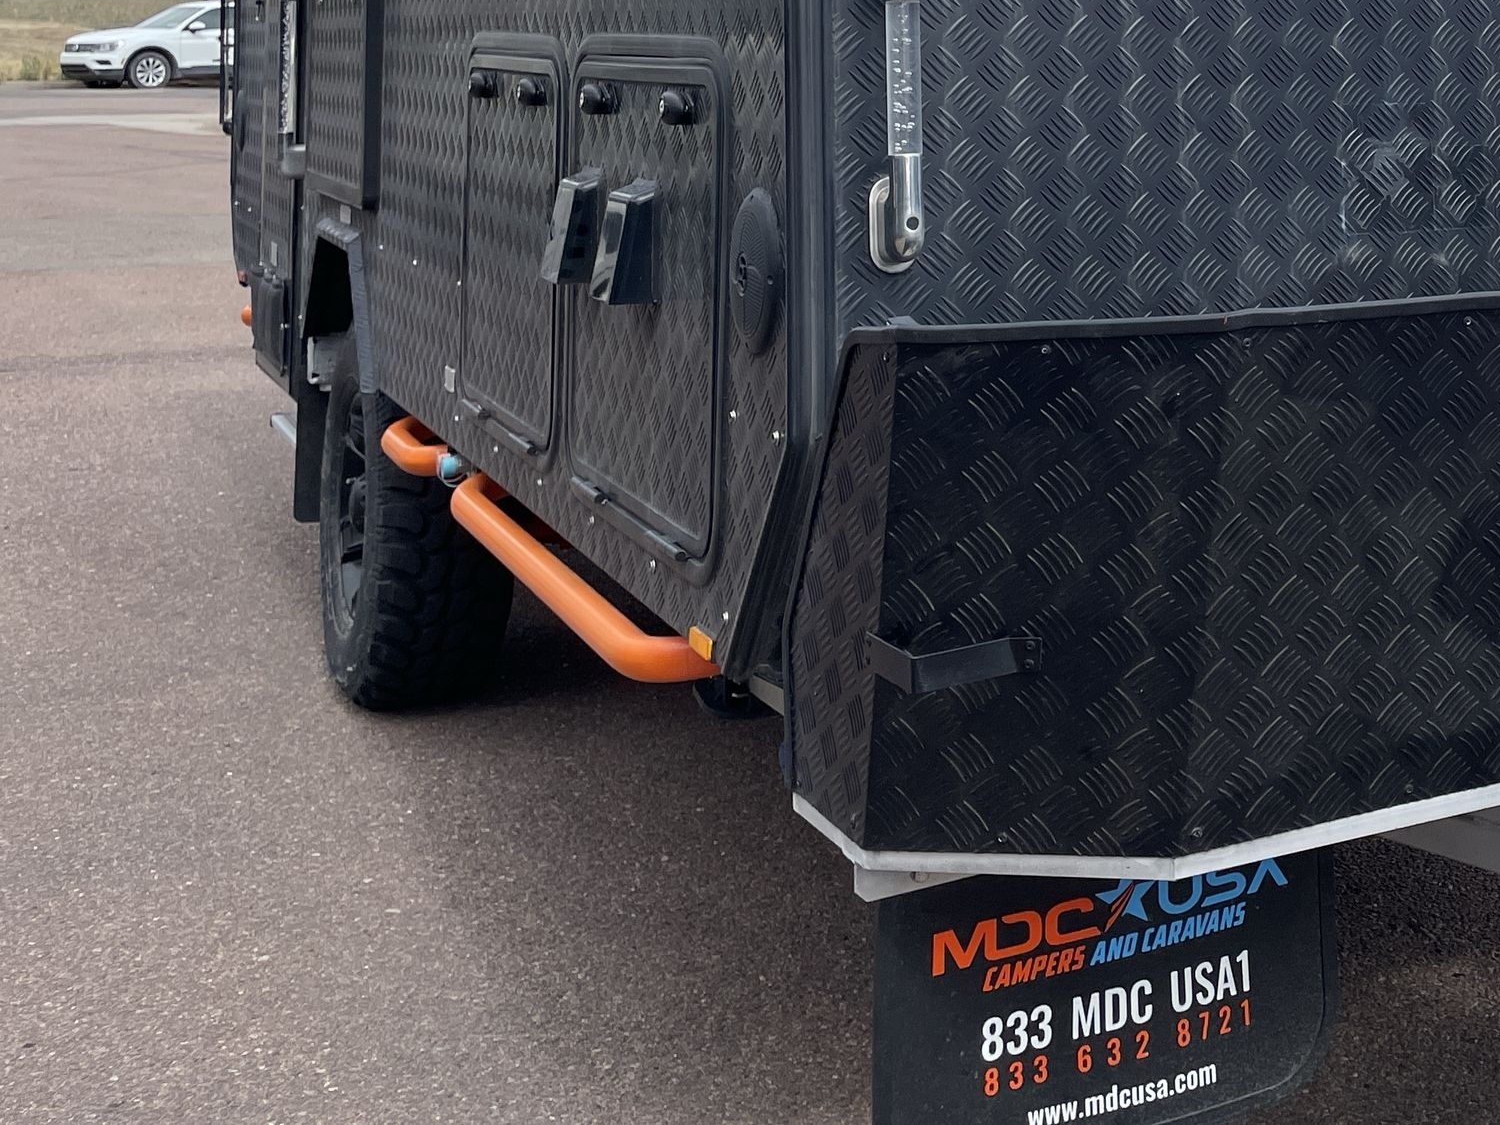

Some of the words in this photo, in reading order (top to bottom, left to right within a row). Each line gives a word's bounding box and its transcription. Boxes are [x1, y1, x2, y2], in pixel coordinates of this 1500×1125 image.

[932, 897, 1101, 977] MDC
[1157, 859, 1289, 915] USA
[982, 944, 1086, 993] CAMPERS
[1089, 932, 1139, 966] AND
[1141, 901, 1246, 953] CARAVANS
[981, 1004, 1053, 1062] 833
[1071, 979, 1153, 1041] MDC
[1170, 949, 1252, 1013] USA1
[983, 1054, 1048, 1097] 833
[1076, 1030, 1150, 1073] 632
[1176, 999, 1252, 1048] 8721
[1027, 1063, 1217, 1125] www.mdcusa.com
